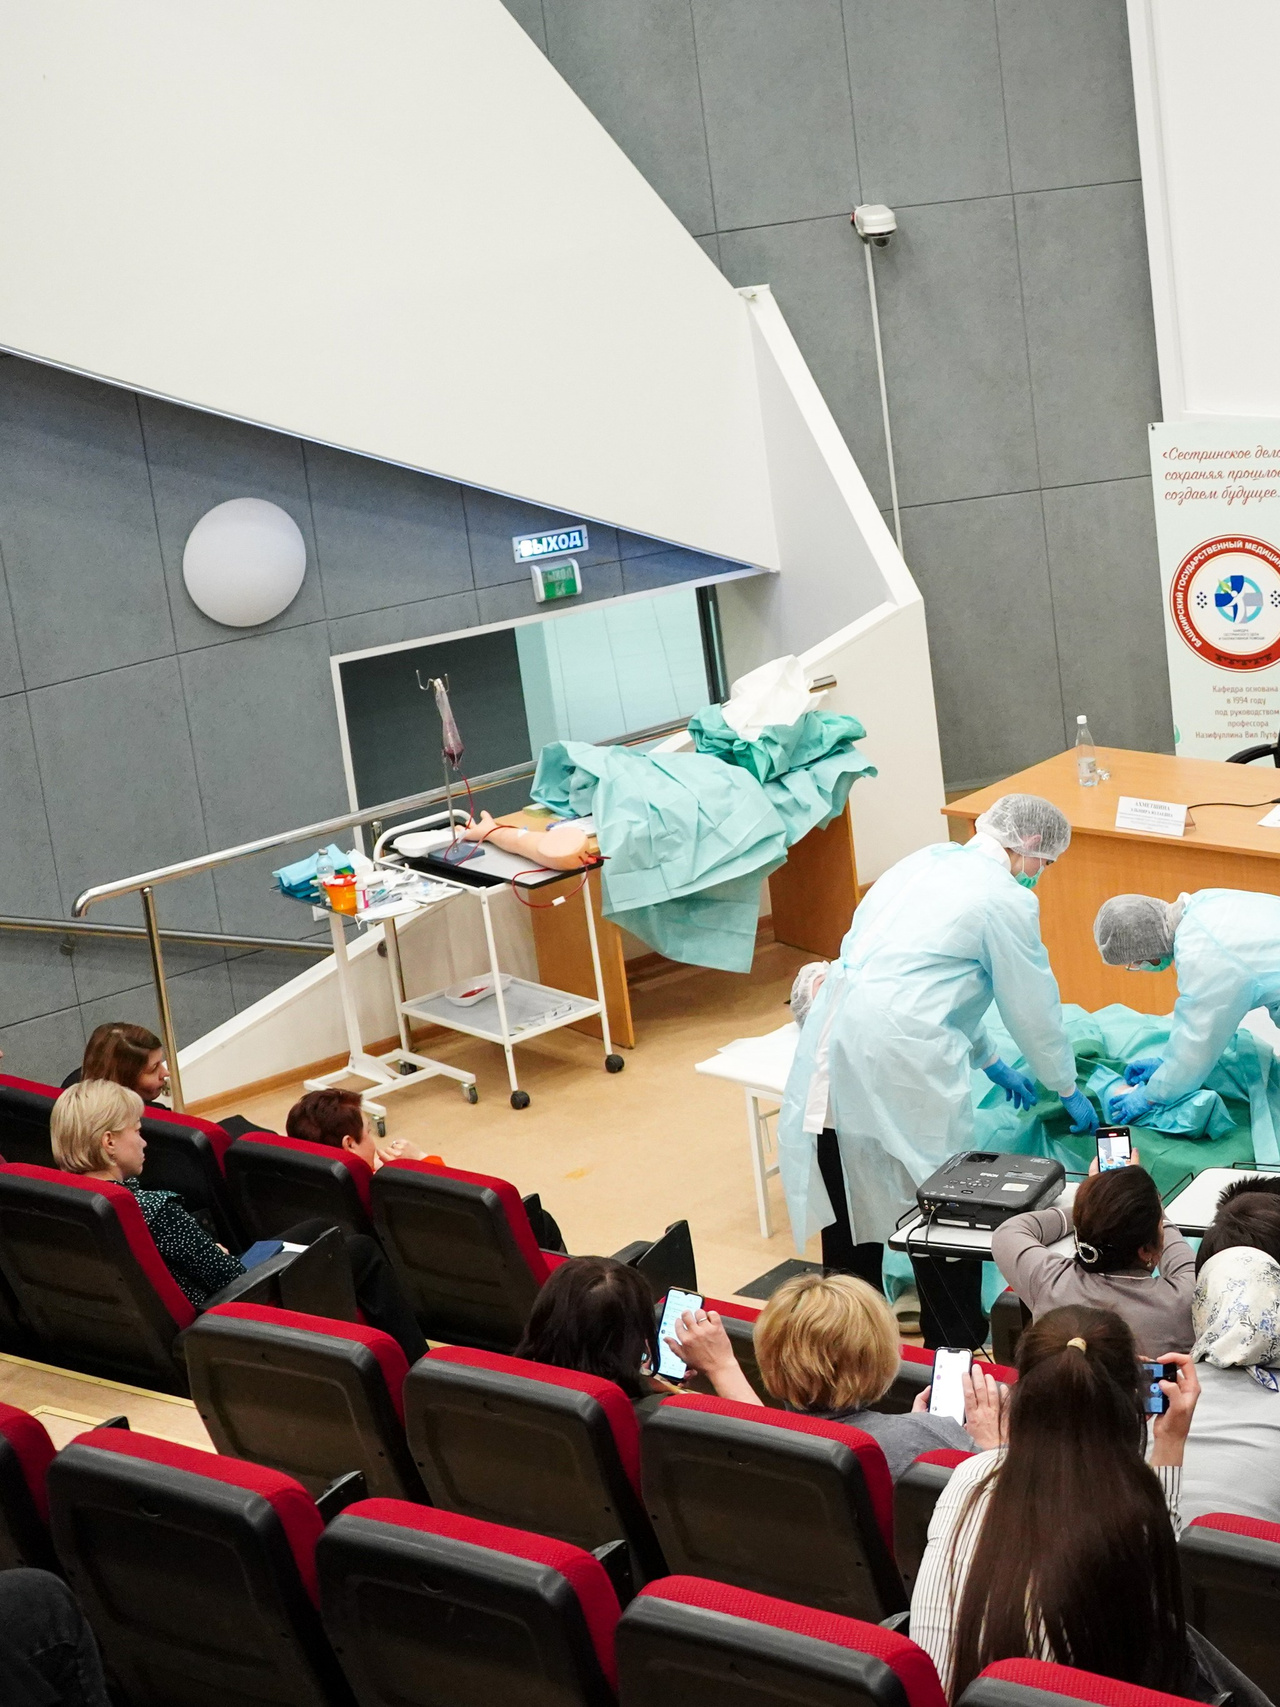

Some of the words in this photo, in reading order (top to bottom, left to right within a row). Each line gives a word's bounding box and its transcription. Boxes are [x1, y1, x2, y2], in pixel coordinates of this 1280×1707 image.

[1165, 471, 1225, 484] сохраняя
[1164, 486, 1218, 505] создаем
[518, 531, 581, 557] ВЫХОД
[1177, 540, 1243, 591] ГОСУДАРСТВЕННЫЙ
[1176, 591, 1203, 648] БАШКИРСКИЙ
[1212, 685, 1244, 694] Кафедра
[1229, 709, 1280, 717] руководством
[1227, 720, 1269, 728] профессора
